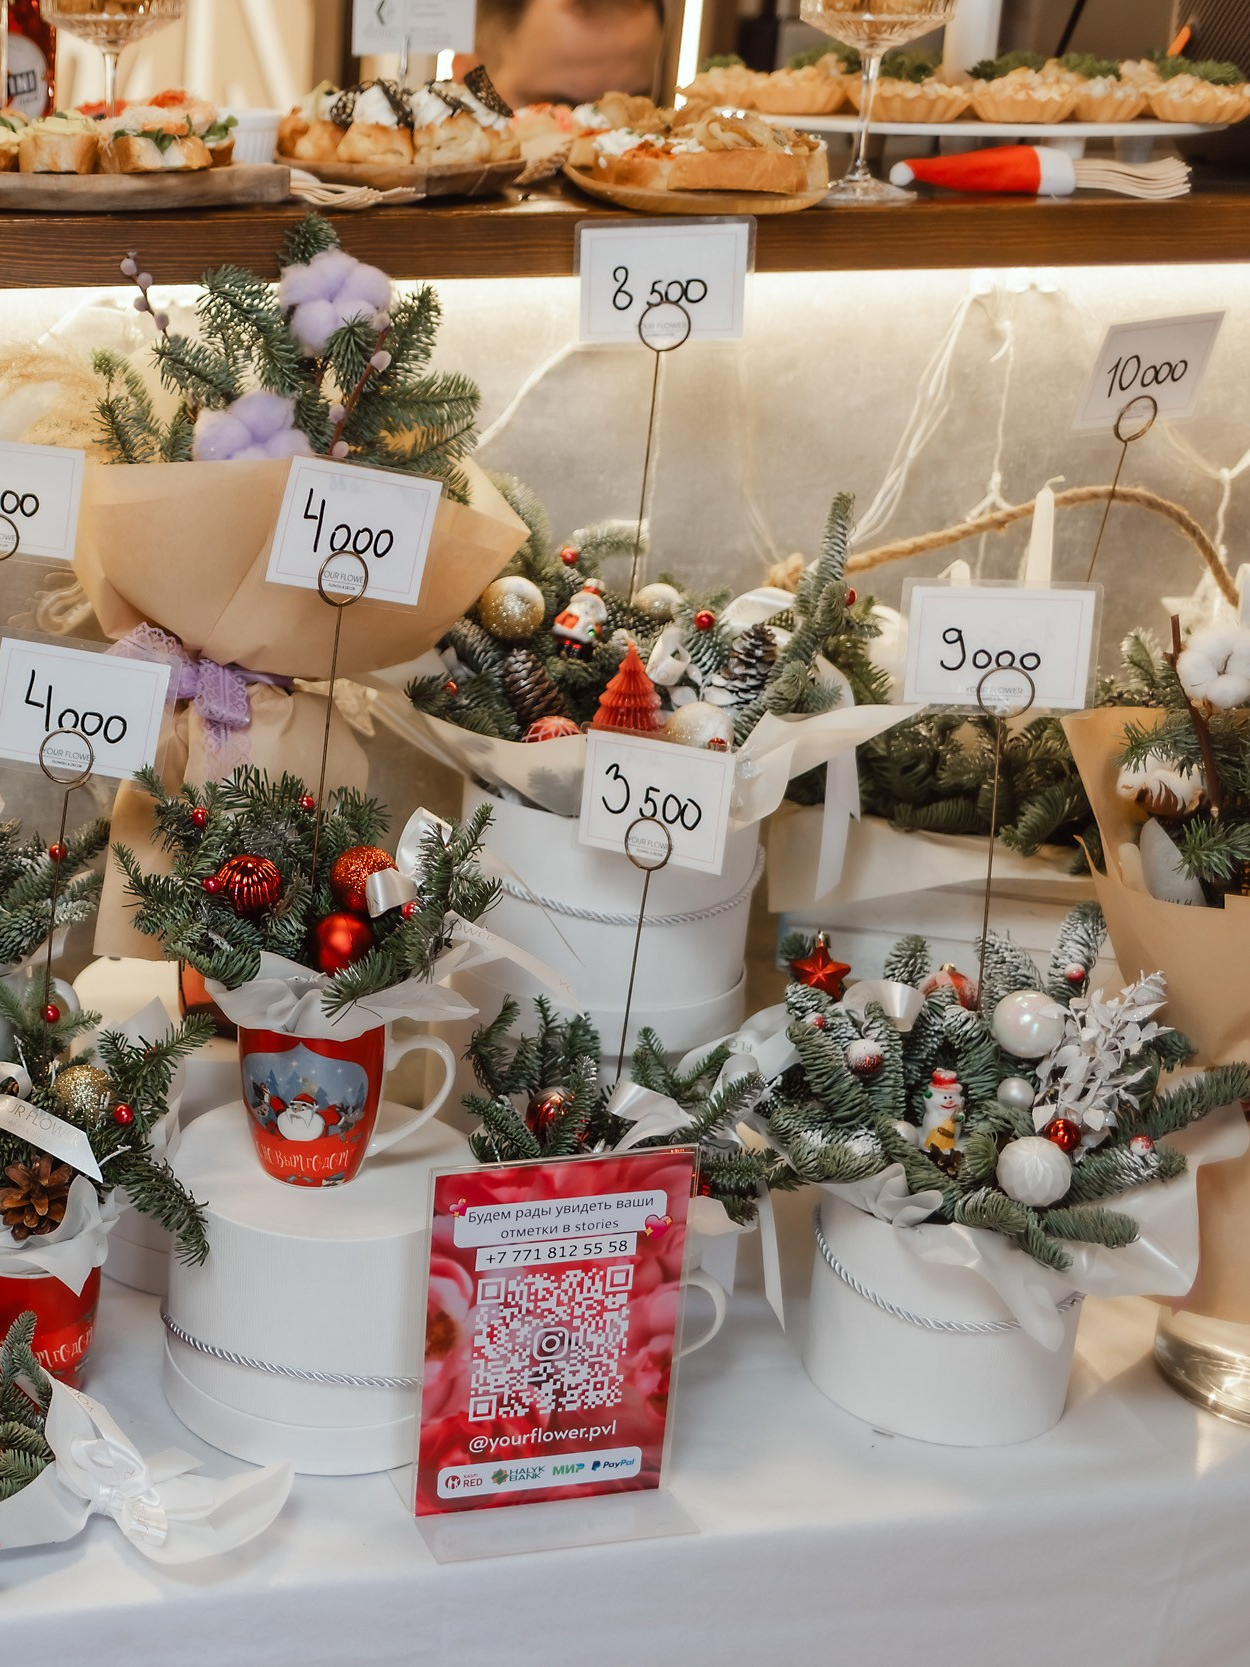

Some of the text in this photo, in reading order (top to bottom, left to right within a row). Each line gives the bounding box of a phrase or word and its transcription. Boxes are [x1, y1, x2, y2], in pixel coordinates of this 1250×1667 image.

[613, 266, 708, 311] 8 500
[340, 572, 366, 584] FLOWE
[602, 763, 702, 831] 3 500
[468, 1196, 654, 1226] Будем рады увидеть ваши
[500, 1218, 619, 1239] отметки в stories
[485, 1239, 628, 1265] +7 771 812 55 58
[468, 1420, 617, 1453] @yourflower.pvl
[509, 1465, 546, 1475] HALYK
[552, 1463, 586, 1476] МИР
[603, 1458, 635, 1469] PayPal
[463, 1478, 483, 1488] RED
[509, 1472, 542, 1482] BANK
